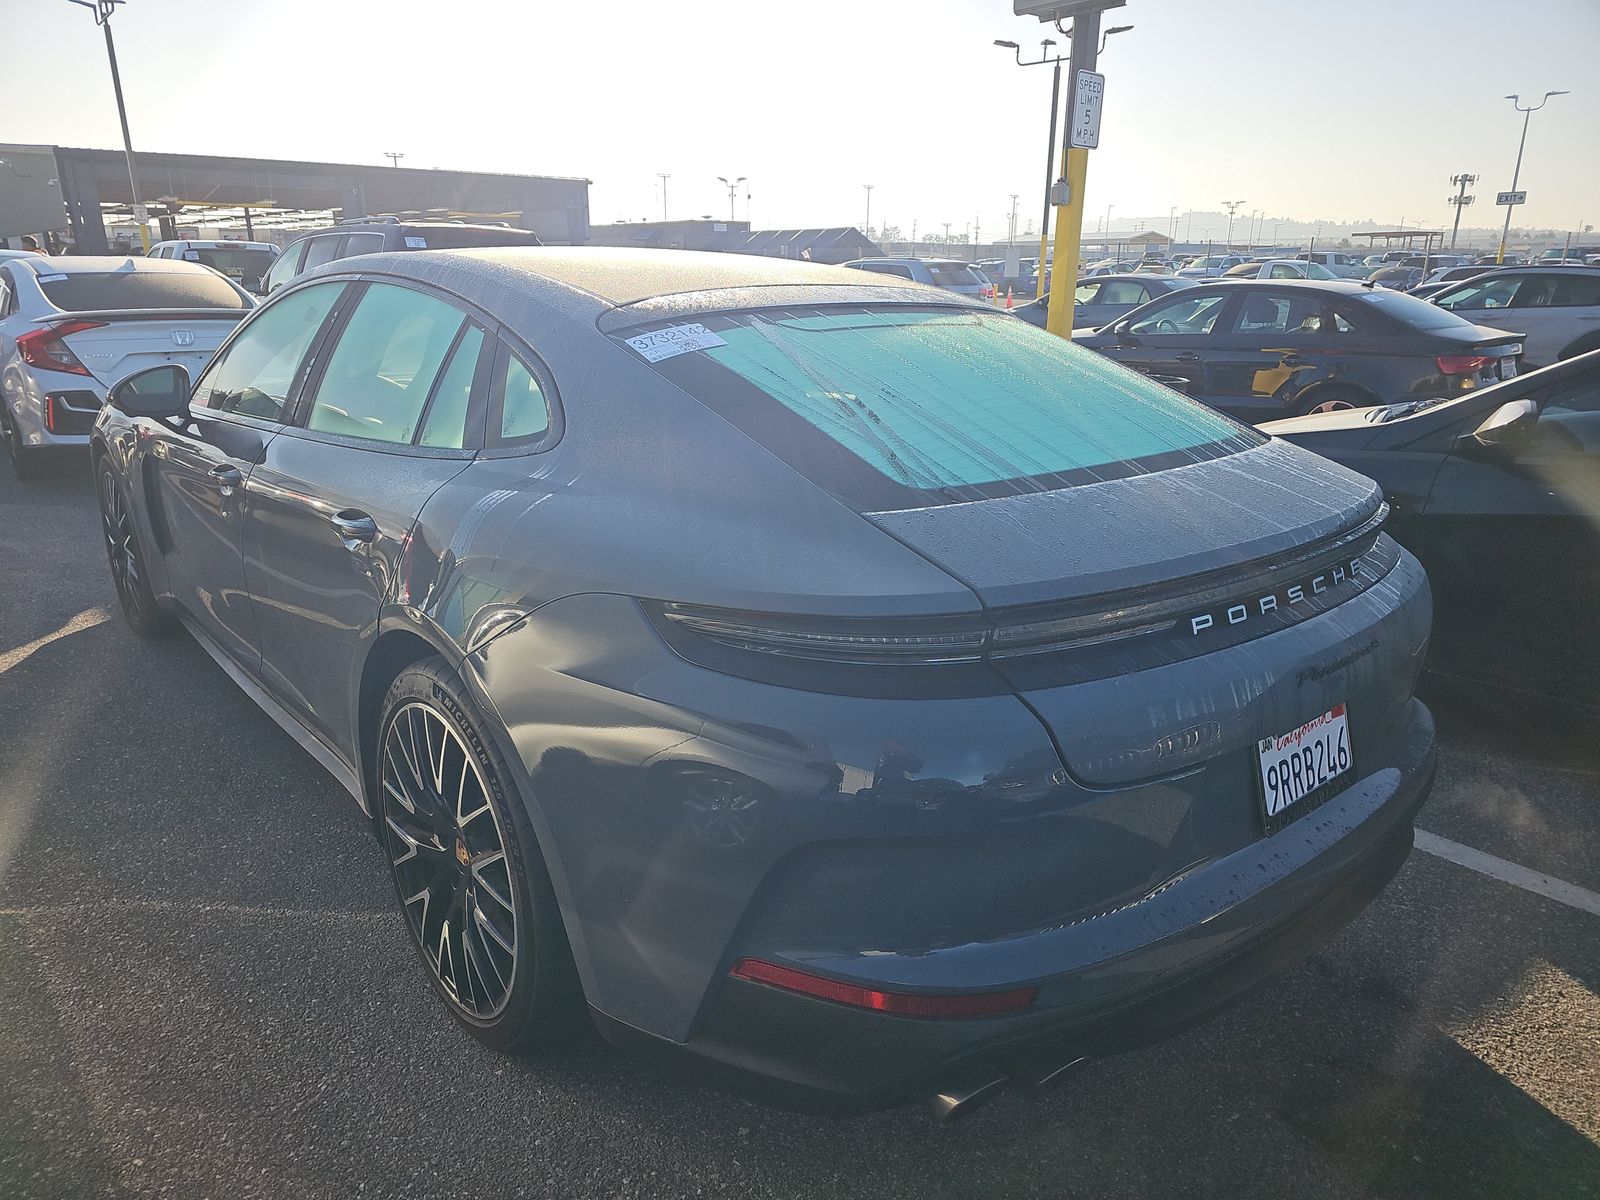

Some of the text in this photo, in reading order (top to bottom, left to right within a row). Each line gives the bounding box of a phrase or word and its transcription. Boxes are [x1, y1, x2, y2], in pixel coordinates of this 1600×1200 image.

[1079, 78, 1102, 93] SPEED
[1080, 93, 1099, 107] LIMIT
[1084, 109, 1091, 125] 5
[1499, 194, 1517, 203] EXIT
[633, 326, 712, 350] 3732142
[1191, 558, 1363, 635] PORSCHE
[443, 697, 489, 765] MICHELIN
[1261, 713, 1333, 754] JAN California
[1267, 725, 1348, 814] 9RRB246
